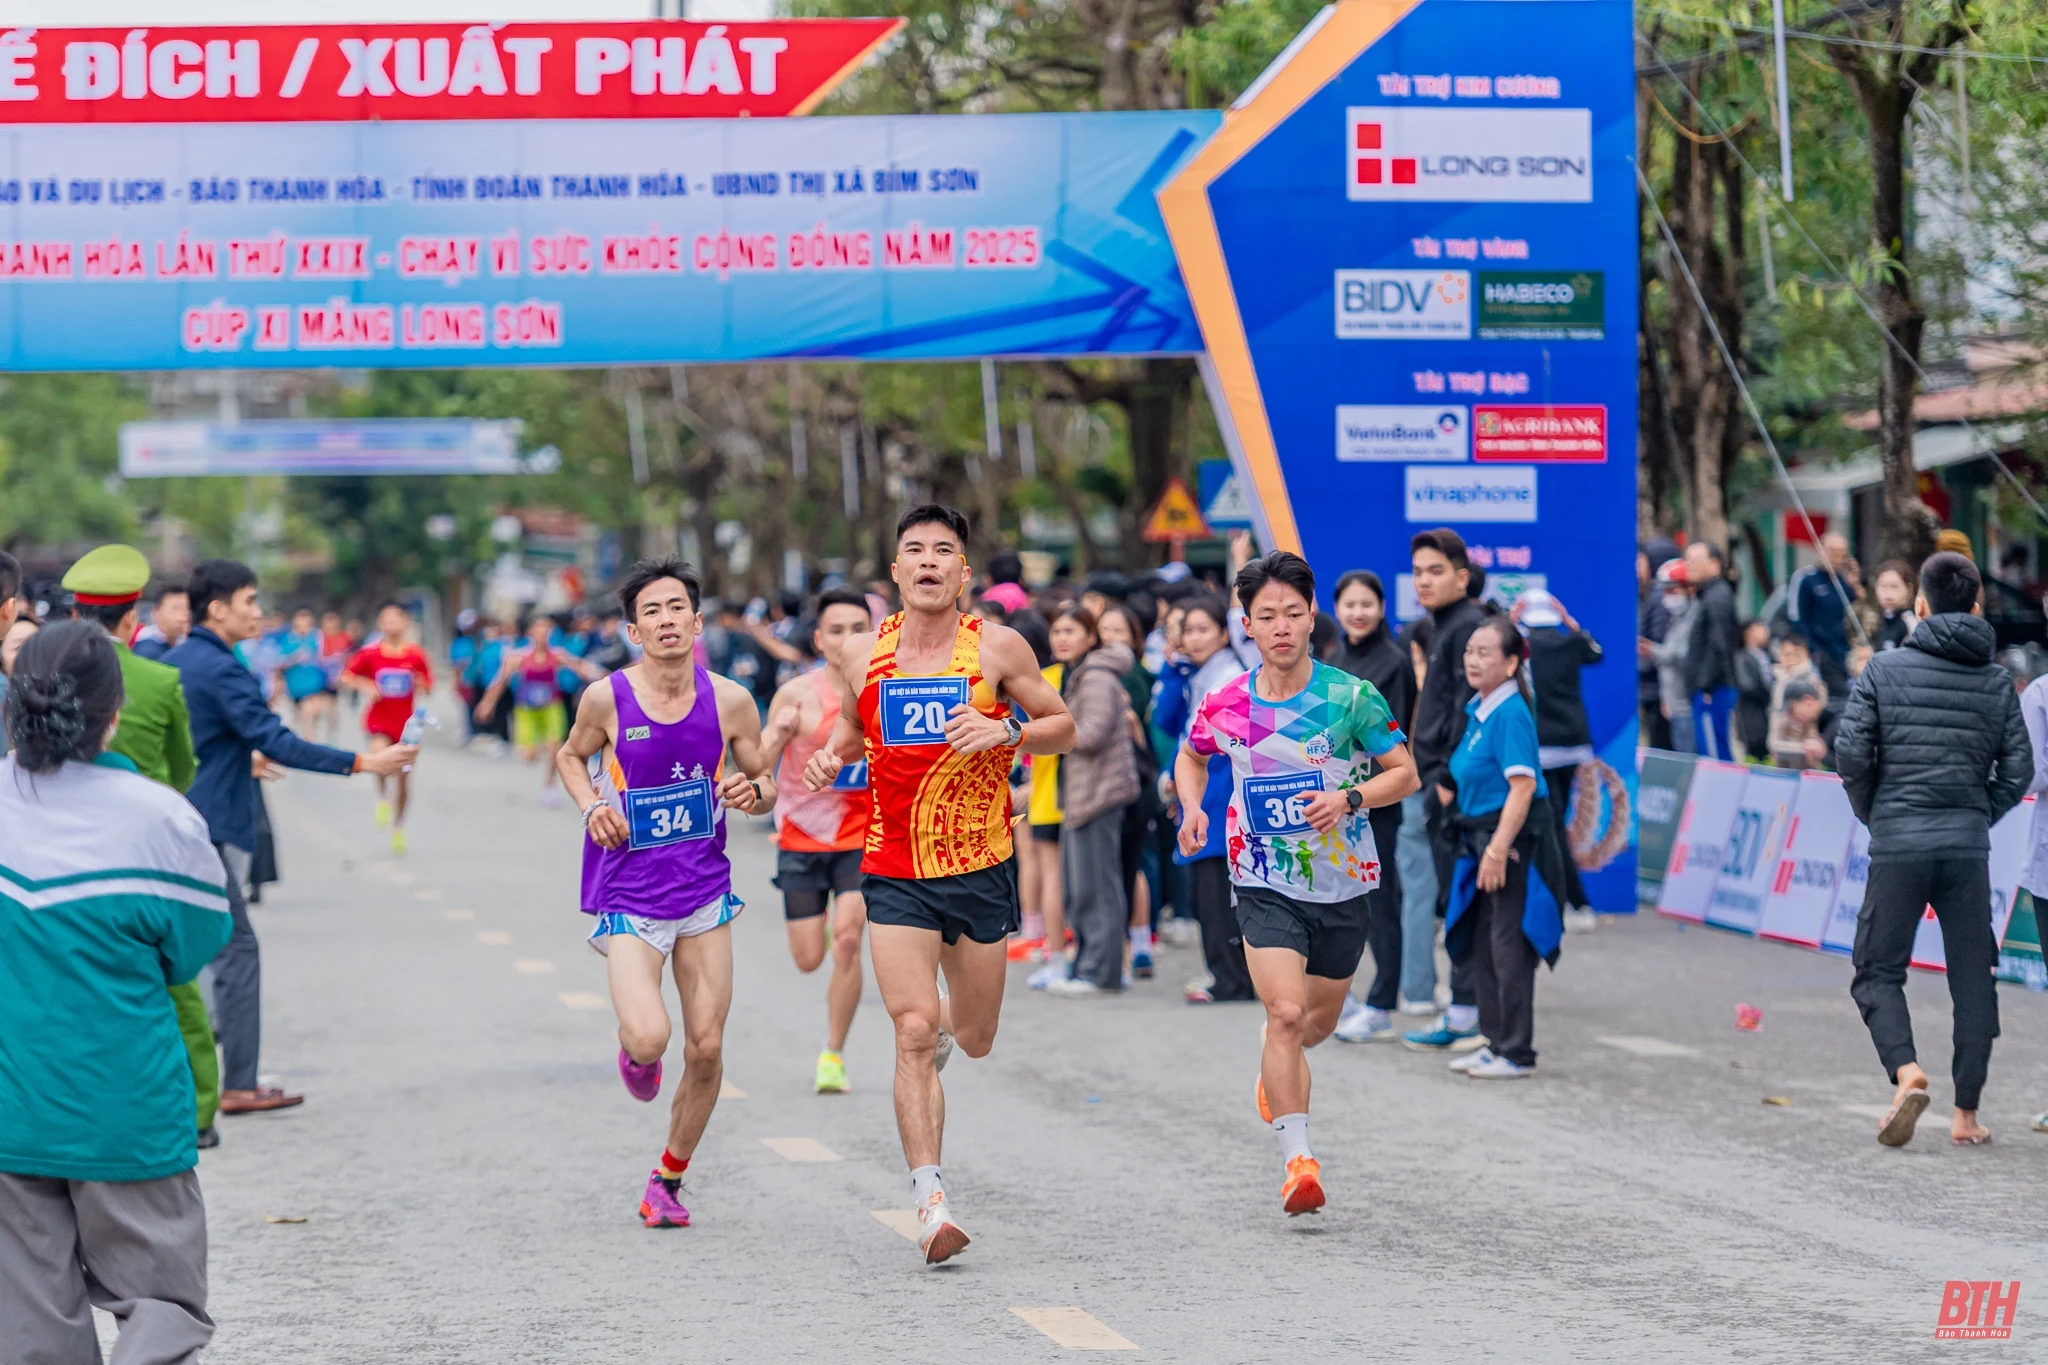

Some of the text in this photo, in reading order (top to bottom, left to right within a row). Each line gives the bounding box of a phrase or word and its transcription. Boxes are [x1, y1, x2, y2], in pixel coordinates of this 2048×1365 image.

[62, 29, 260, 100] ĐÍCH
[336, 19, 554, 98] XUẤT
[574, 25, 789, 97] PHÁT
[1421, 155, 1510, 177] LONG
[248, 178, 328, 202] THANH
[551, 174, 632, 198] THANH
[713, 172, 779, 196] UBND
[83, 233, 145, 276] HÓA
[294, 240, 369, 274] XXIX
[400, 239, 481, 284] CHẠY
[530, 228, 590, 272] SỨC
[695, 229, 776, 280] CỘNG
[789, 221, 872, 267] ĐỒNG
[884, 224, 953, 267] NĂM
[966, 230, 1038, 266] 2025
[1343, 278, 1433, 314] BIDV
[1483, 282, 1575, 304] HABECO
[185, 299, 561, 344] CÚP XI MĂNG LONG SƠN
[1411, 480, 1531, 506] vinaphone
[903, 701, 946, 735] 20
[1306, 744, 1326, 755] HFC
[650, 805, 693, 838] 34
[1265, 797, 1306, 829] 36
